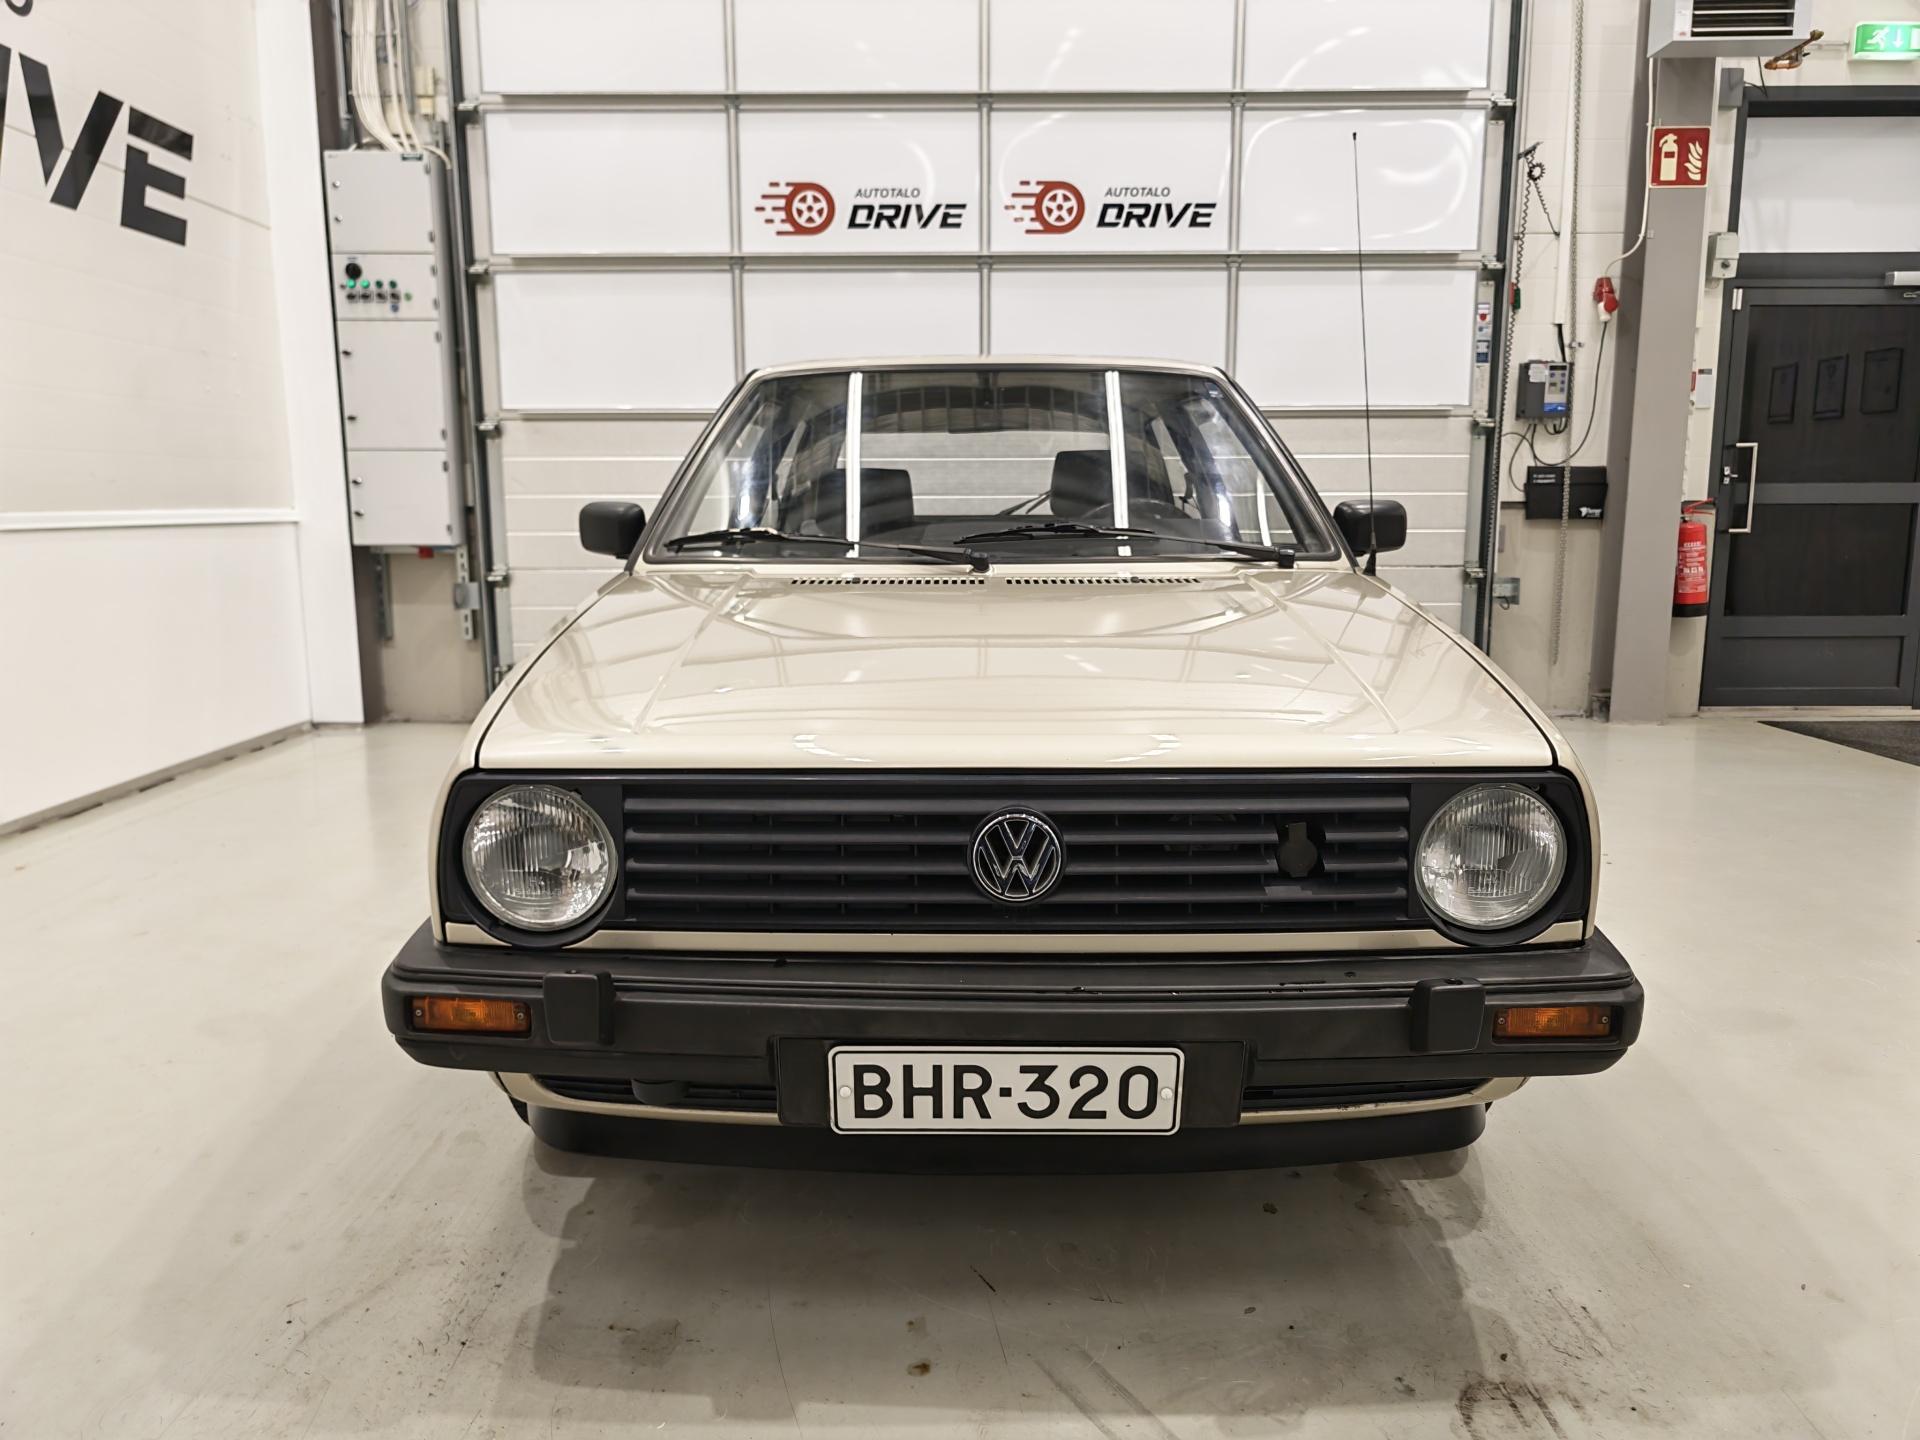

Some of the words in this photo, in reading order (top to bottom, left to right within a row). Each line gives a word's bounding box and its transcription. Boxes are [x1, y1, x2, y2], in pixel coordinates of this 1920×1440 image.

[854, 187, 921, 199] AUTOTALO
[1104, 186, 1171, 198] AUTOTALO
[847, 203, 967, 230] DRIVE
[1096, 202, 1217, 228] DRIVE
[853, 1063, 1159, 1120] BHR-320
